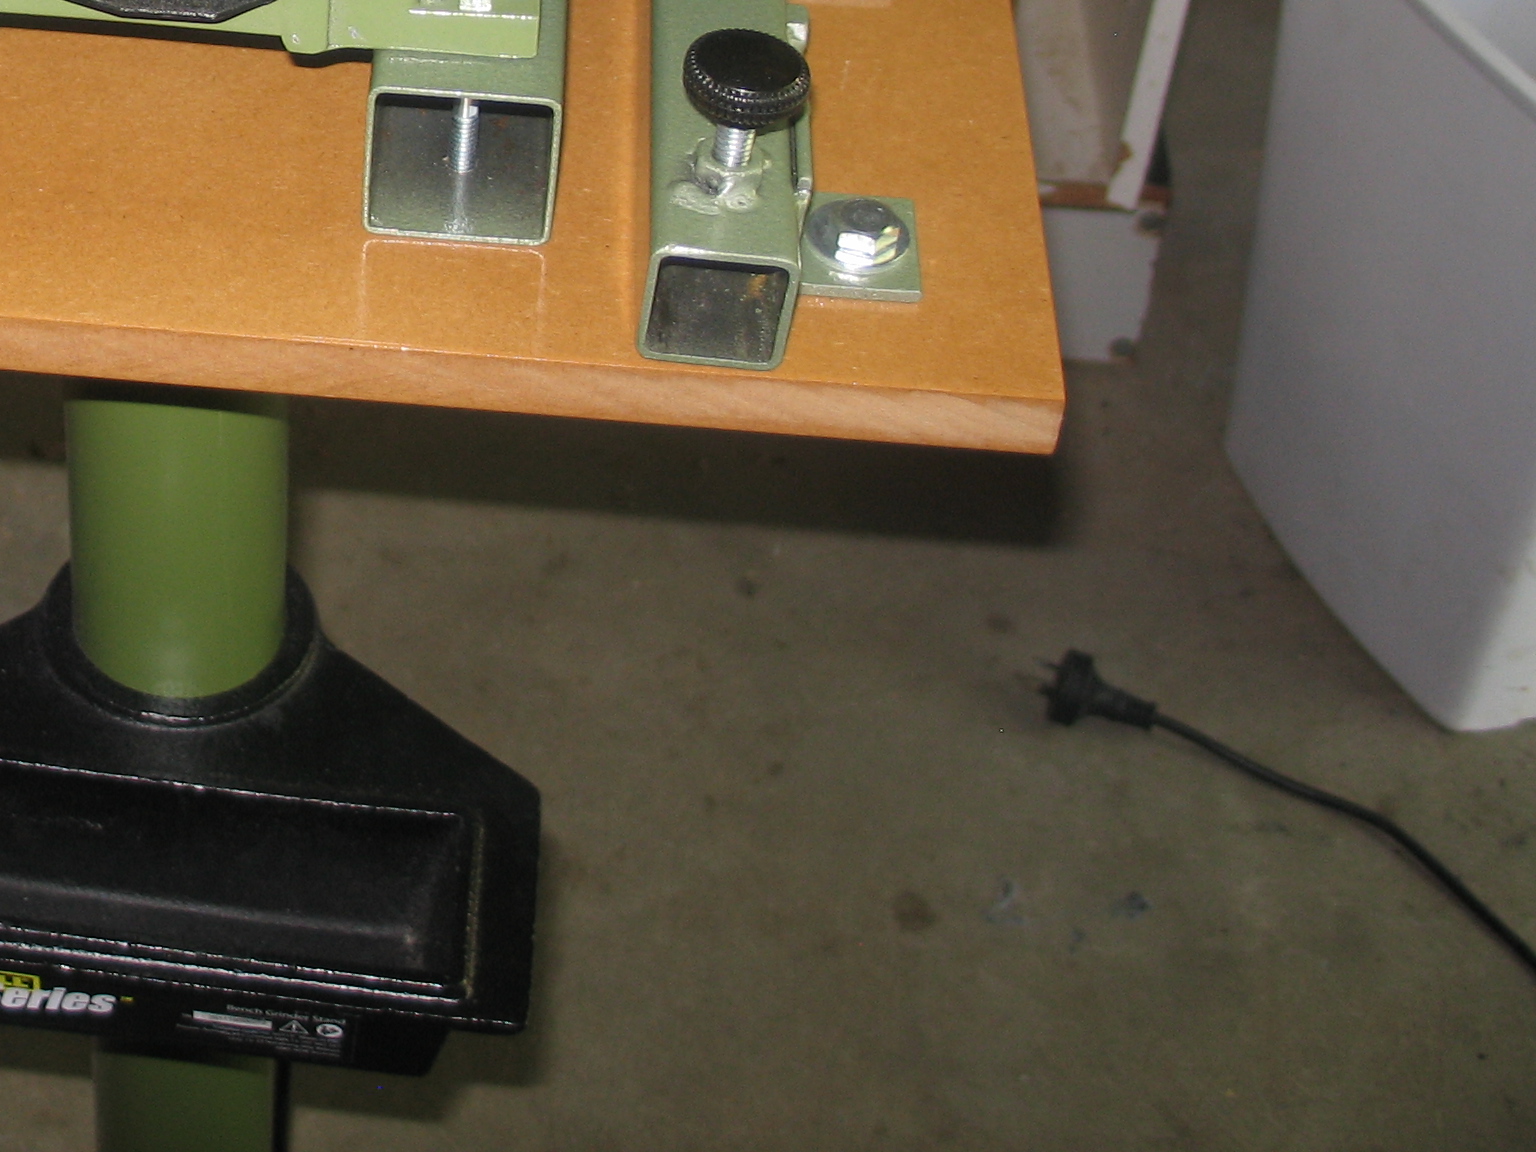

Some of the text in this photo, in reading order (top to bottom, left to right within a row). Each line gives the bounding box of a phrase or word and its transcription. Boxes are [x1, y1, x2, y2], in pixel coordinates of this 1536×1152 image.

[226, 1003, 263, 1015] Bench
[265, 1009, 310, 1022] Grinder
[312, 1015, 346, 1025] Stand
